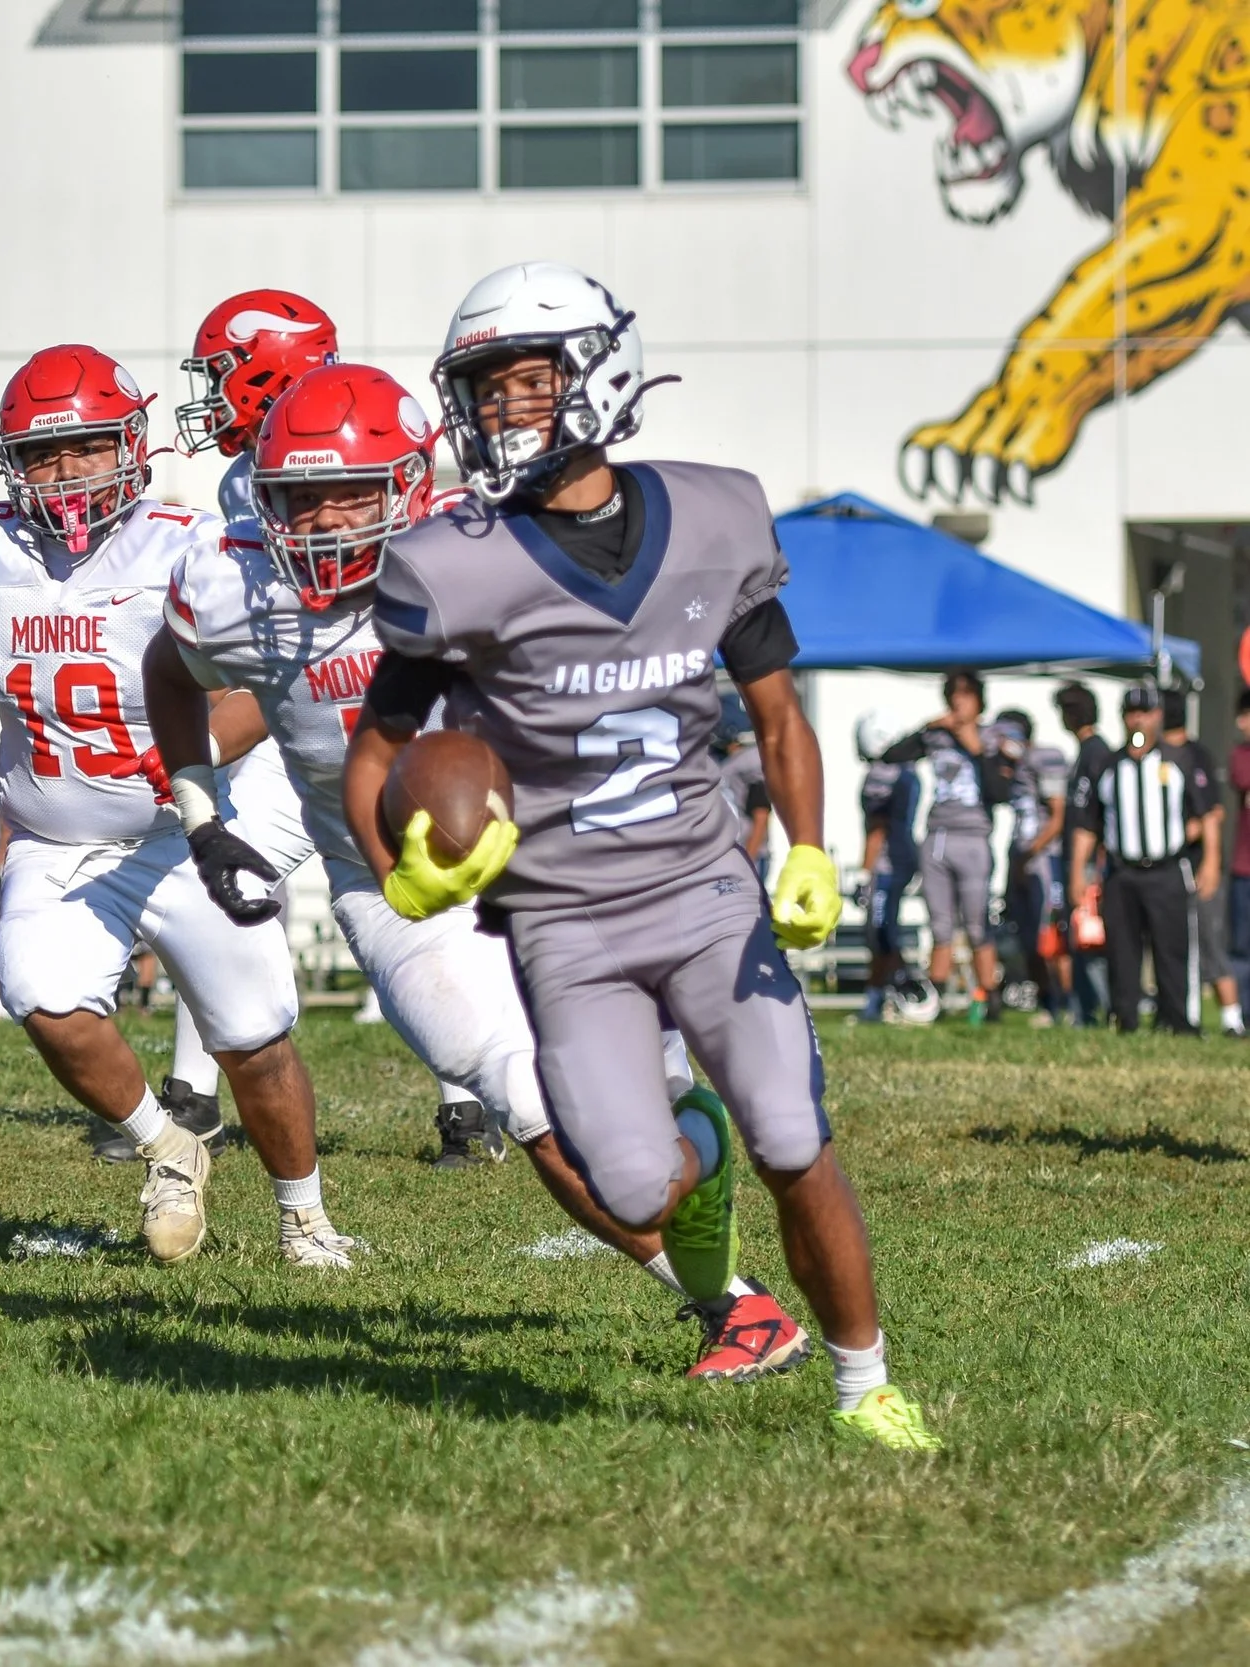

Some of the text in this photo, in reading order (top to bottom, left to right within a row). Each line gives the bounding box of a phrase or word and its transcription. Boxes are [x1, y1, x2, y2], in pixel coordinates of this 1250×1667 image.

[456, 326, 498, 349] Riddell
[288, 453, 334, 466] Riddell
[11, 615, 108, 653] MONROE
[303, 649, 386, 704] MON
[544, 649, 707, 695] JAGUARS
[5, 662, 139, 779] 19
[569, 704, 683, 836] 2
